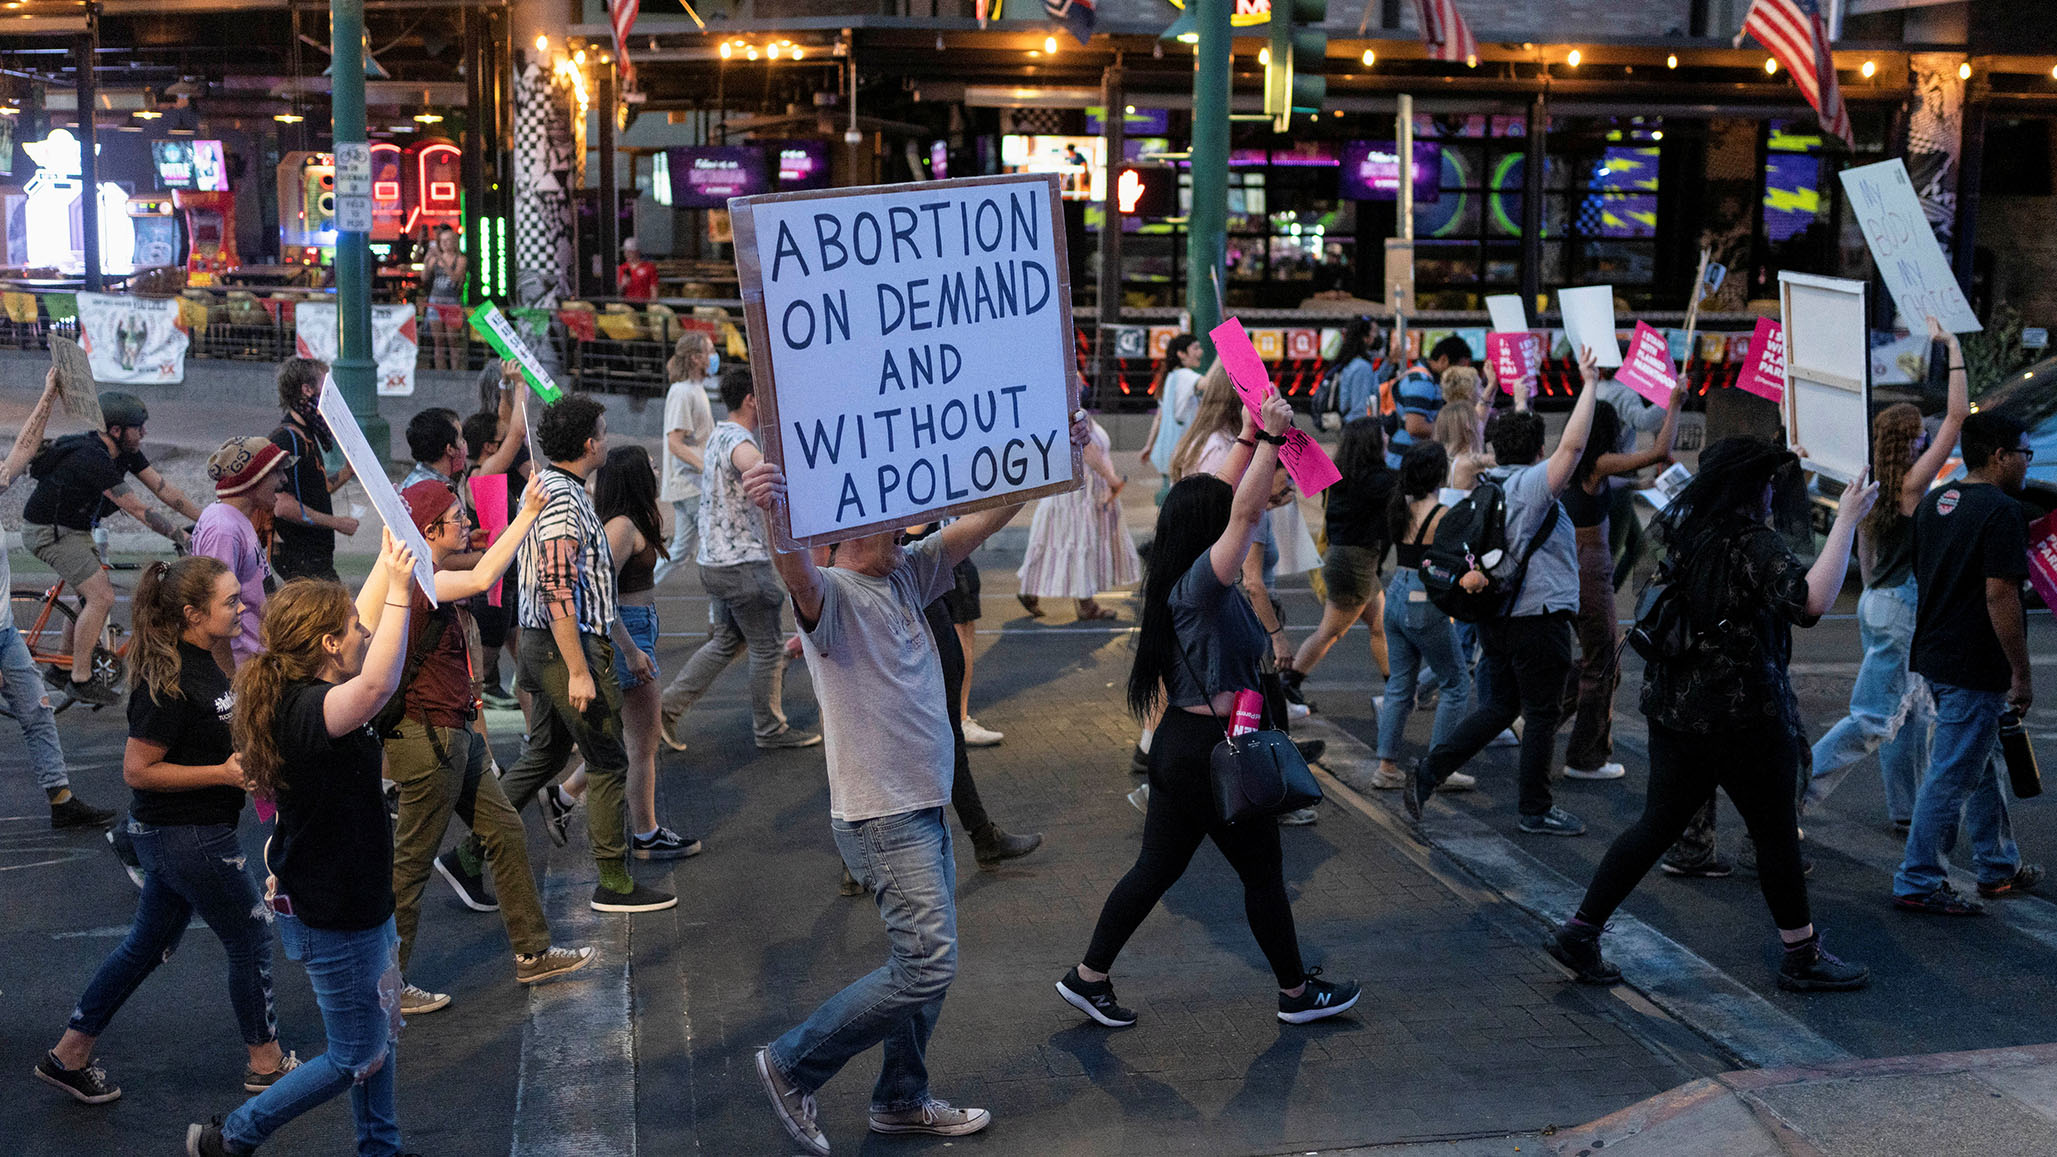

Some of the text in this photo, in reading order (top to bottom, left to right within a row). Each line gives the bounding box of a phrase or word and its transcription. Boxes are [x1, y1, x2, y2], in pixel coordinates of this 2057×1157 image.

[771, 190, 1038, 282] ABORTION
[782, 260, 1051, 350] ON DEMAND
[386, 375, 406, 388] XX
[878, 344, 962, 395] AND
[794, 385, 1027, 470] WITHOUT
[835, 430, 1057, 523] APOLOGY
[1314, 992, 1331, 1006] N
